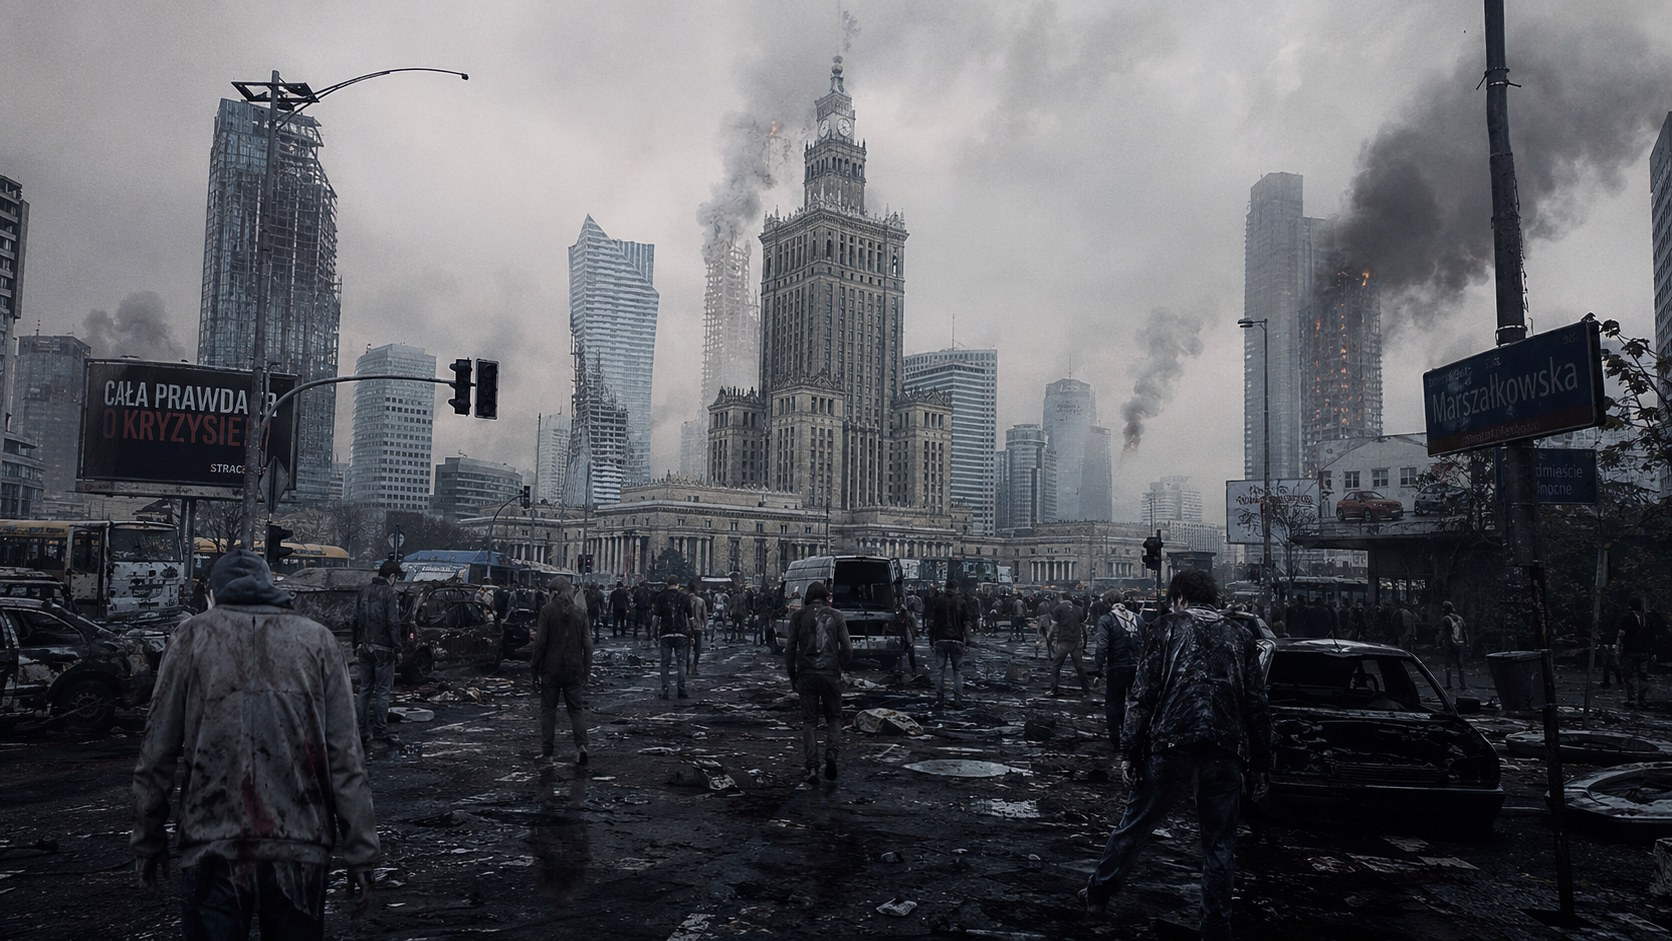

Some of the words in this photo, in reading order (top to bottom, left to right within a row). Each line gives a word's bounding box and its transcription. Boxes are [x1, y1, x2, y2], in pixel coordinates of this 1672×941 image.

[104, 380, 149, 408] CAŁA
[154, 383, 249, 415] PRAWDA
[1432, 356, 1579, 424] Marszałkowska
[103, 408, 117, 440] O
[123, 408, 270, 448] KRYZYSIE
[1535, 463, 1583, 478] dmieście
